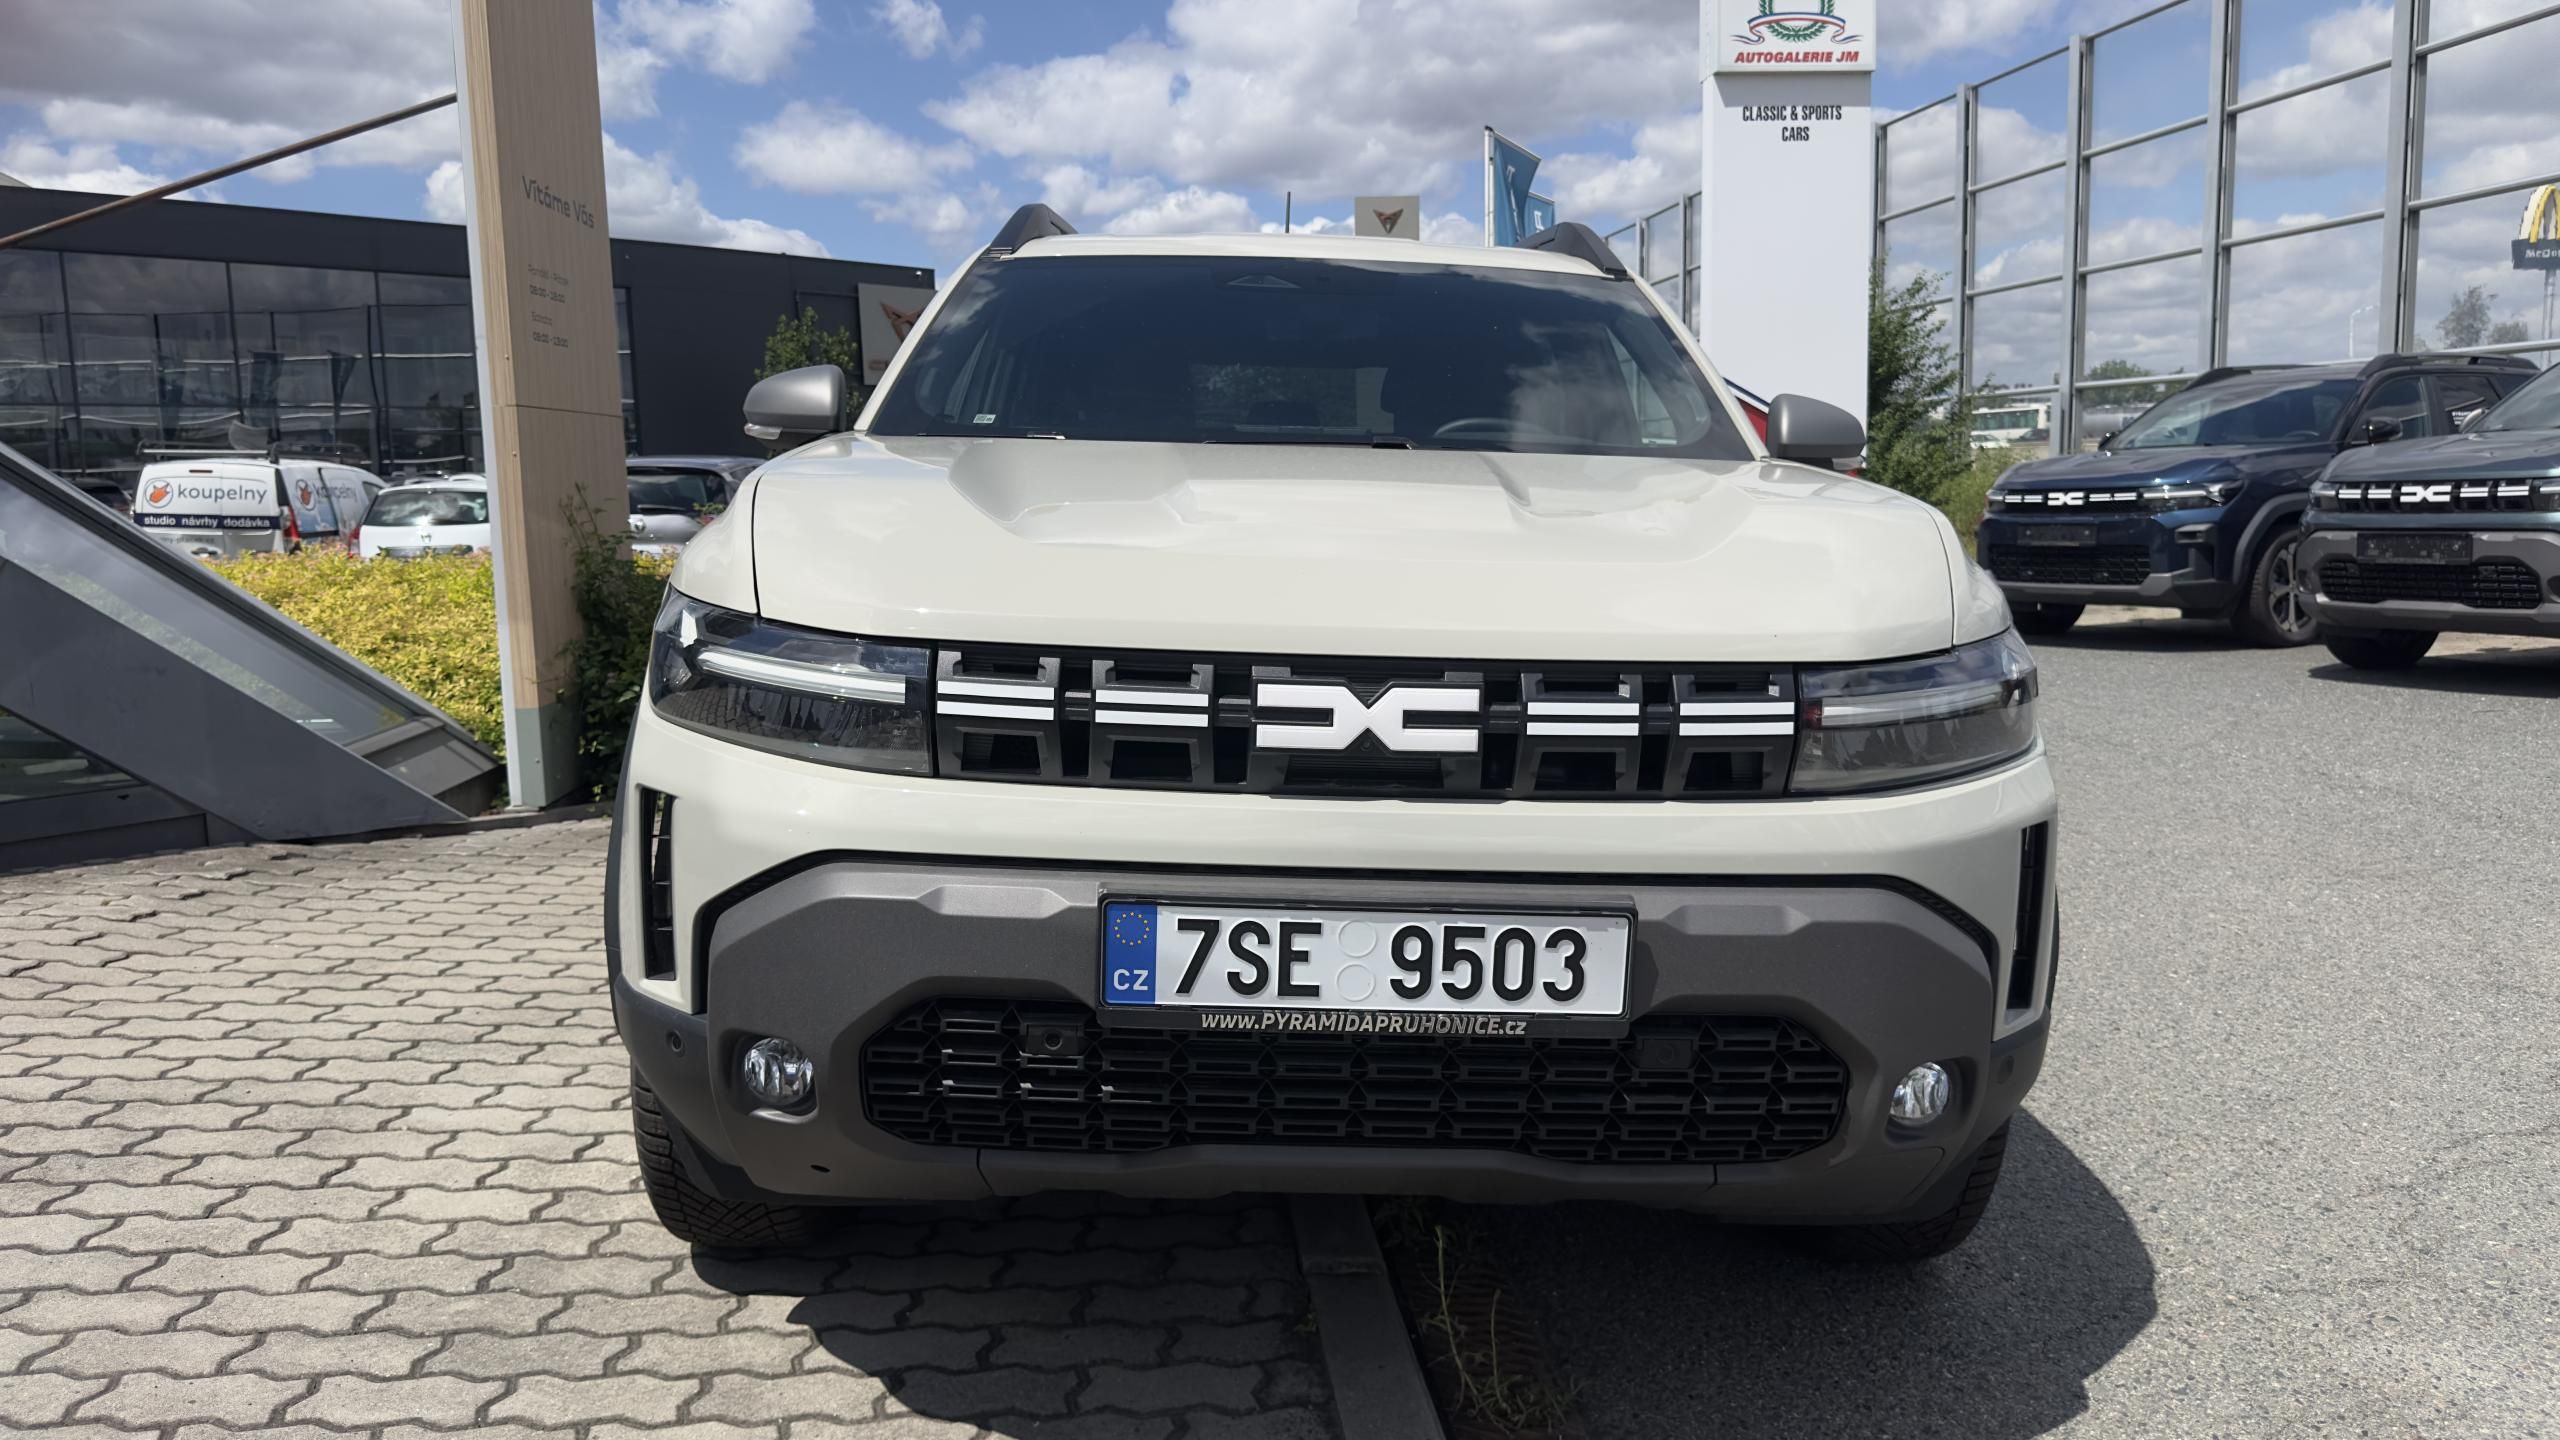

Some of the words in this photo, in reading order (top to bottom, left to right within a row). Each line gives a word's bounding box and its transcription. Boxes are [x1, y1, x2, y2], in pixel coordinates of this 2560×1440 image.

[1734, 51, 1834, 63] AUTOGALERIE
[1836, 51, 1860, 62] JM
[1742, 106, 1787, 121] CLASSIC
[1790, 106, 1799, 120] &
[1801, 105, 1842, 120] SPORTS
[1782, 127, 1810, 141] CARS
[521, 175, 571, 218] Vítáme
[572, 200, 594, 228] Vás
[177, 484, 268, 504] koupelny
[144, 515, 176, 526] studio
[181, 515, 218, 528] návrhy
[223, 517, 270, 528] dodávka
[1113, 969, 1149, 991] CZ
[1175, 918, 1321, 997] 7SE
[1390, 924, 1586, 1002] 9503
[1201, 1011, 1527, 1036] www.PYRAMIDAPRUHONICE.cz
